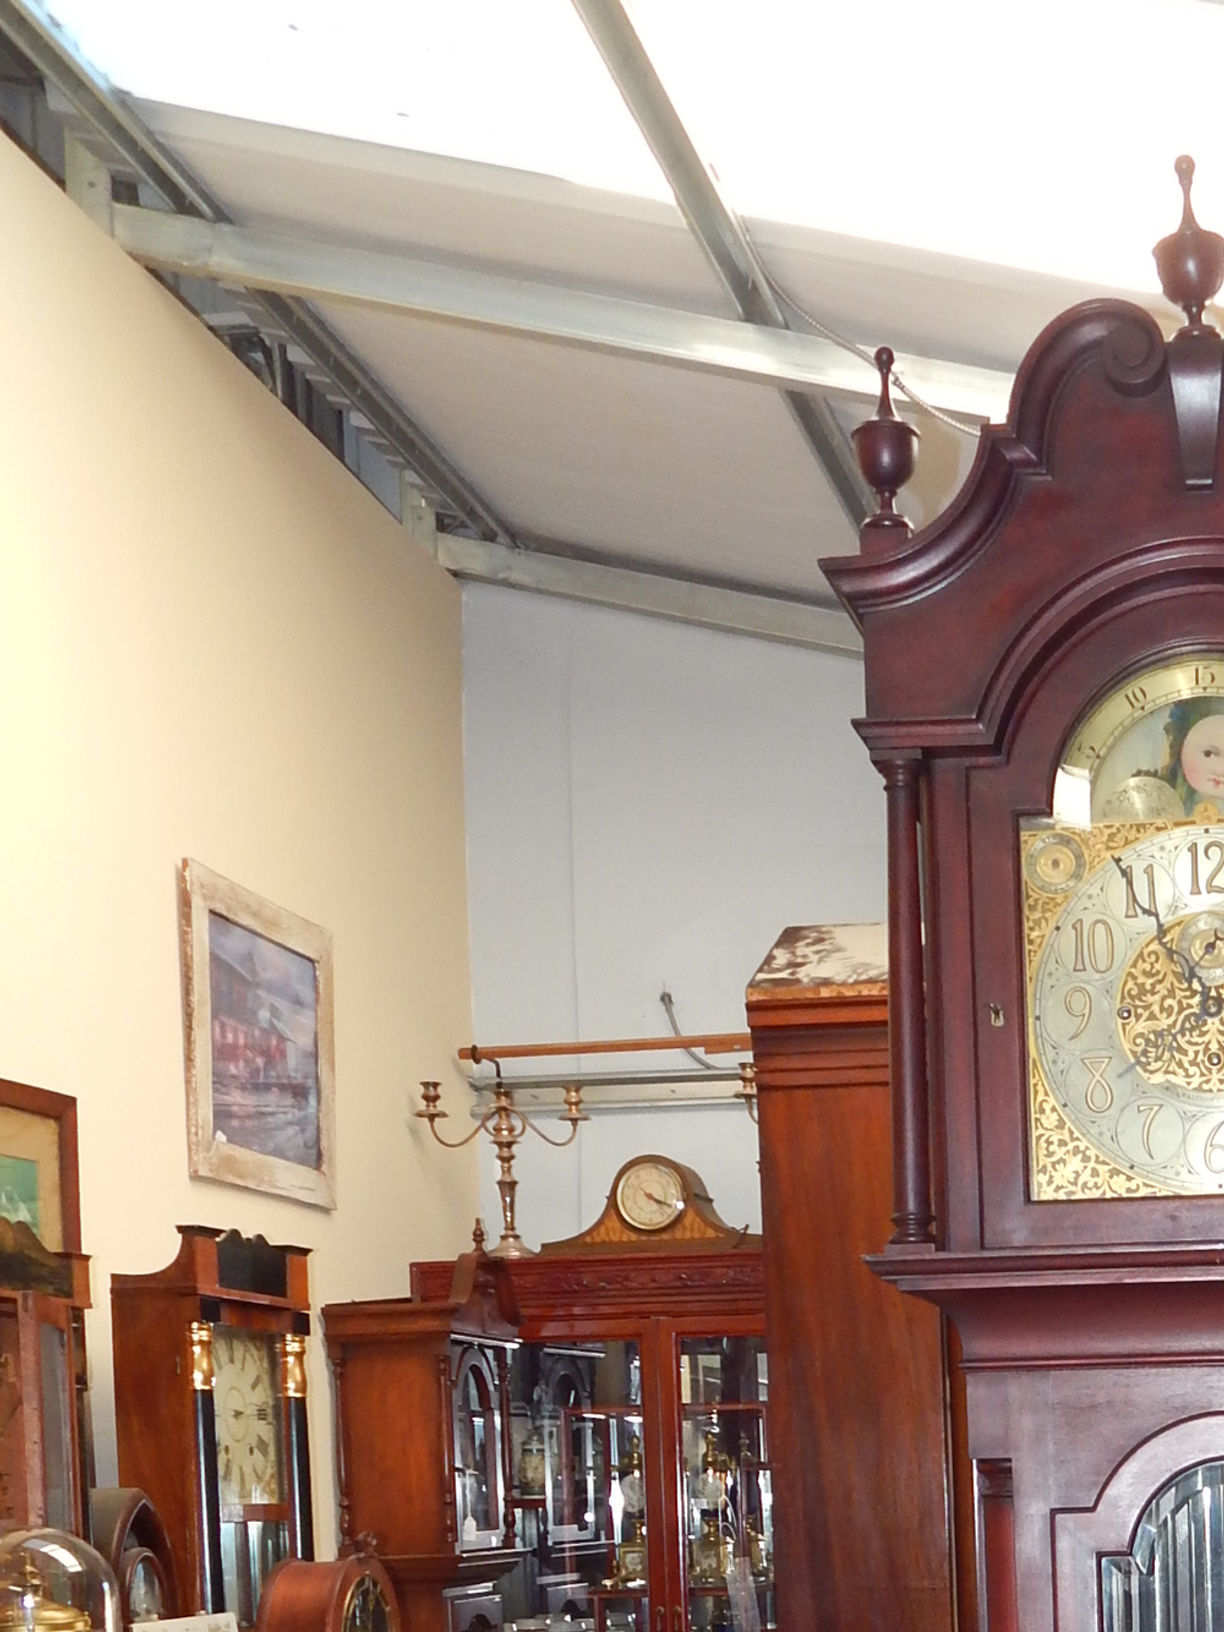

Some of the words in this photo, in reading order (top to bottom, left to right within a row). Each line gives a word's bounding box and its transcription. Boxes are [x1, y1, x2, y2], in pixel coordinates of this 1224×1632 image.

[1124, 686, 1147, 710] 10
[1193, 667, 1215, 686] 15
[1122, 863, 1158, 918] 11
[1072, 918, 1114, 974] 10
[1064, 986, 1091, 1041] 9
[1081, 1056, 1114, 1113] 8
[1137, 1104, 1164, 1160] 7
